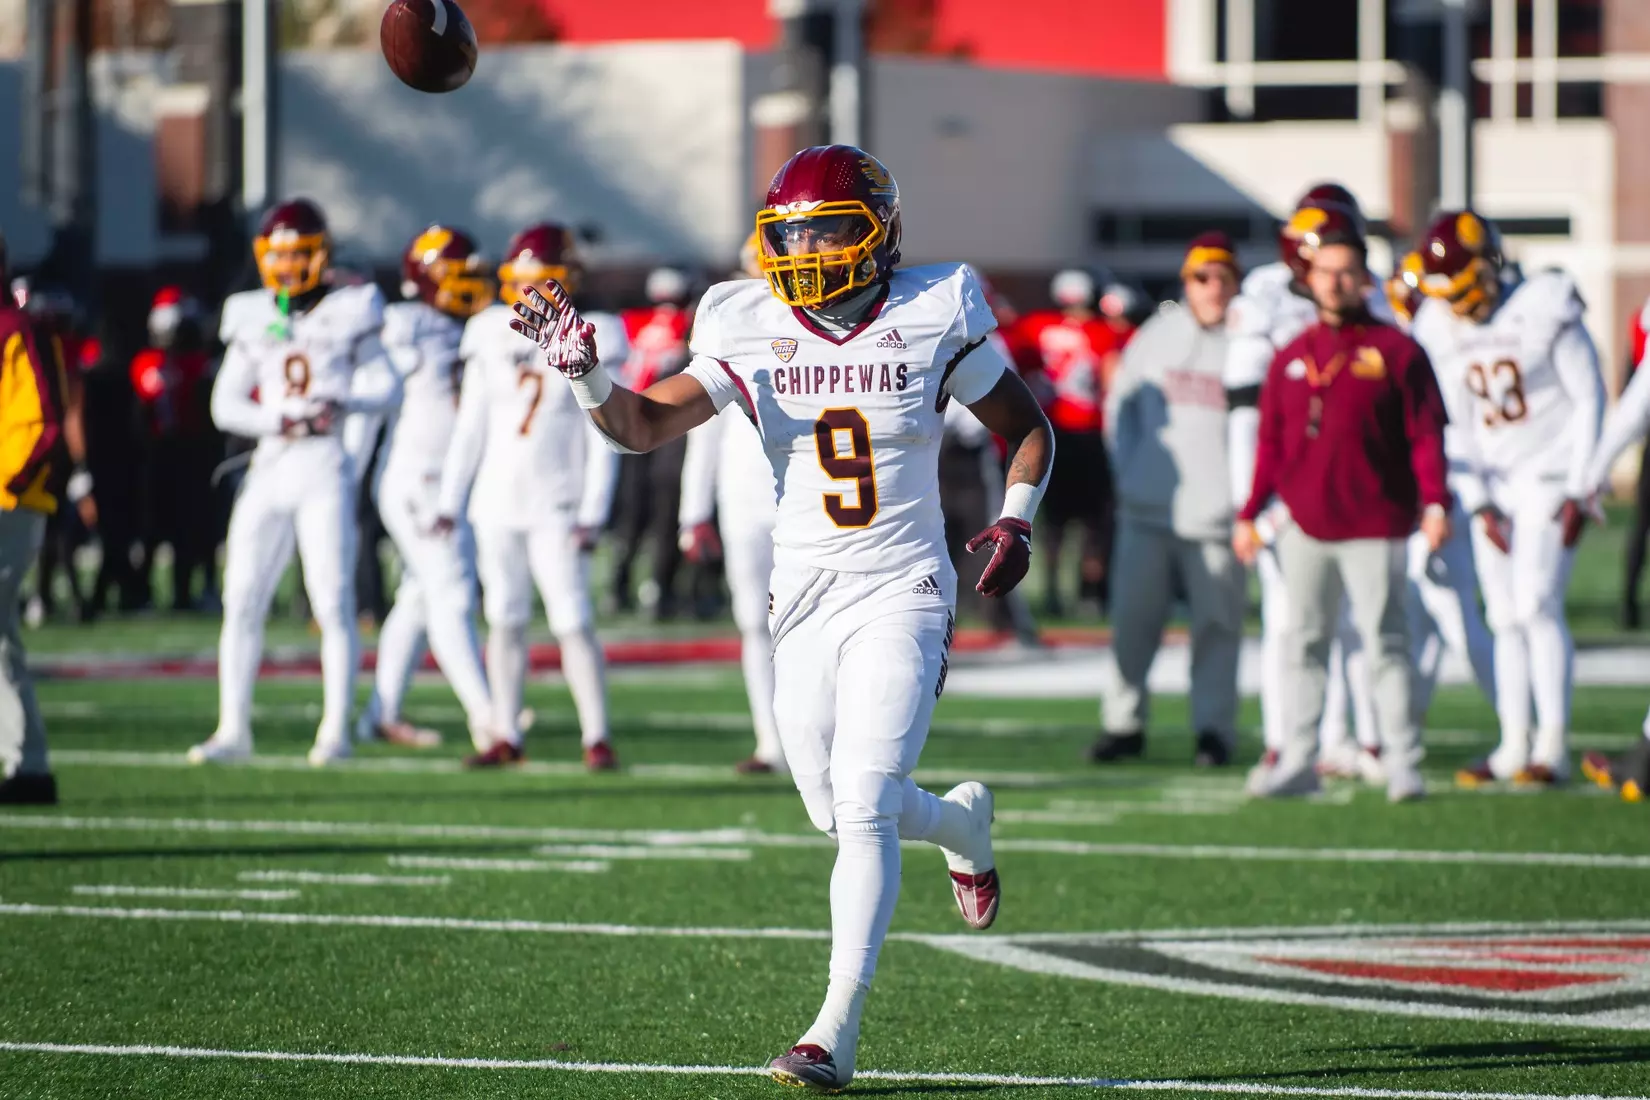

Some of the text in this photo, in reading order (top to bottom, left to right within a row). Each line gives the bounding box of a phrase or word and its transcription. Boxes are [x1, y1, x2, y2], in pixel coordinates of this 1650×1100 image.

[773, 344, 797, 354] MAC
[876, 339, 908, 349] adidas
[773, 363, 908, 395] CHIPPEWAS
[516, 370, 545, 436] 7
[814, 406, 879, 528] 9
[912, 585, 942, 596] adidas
